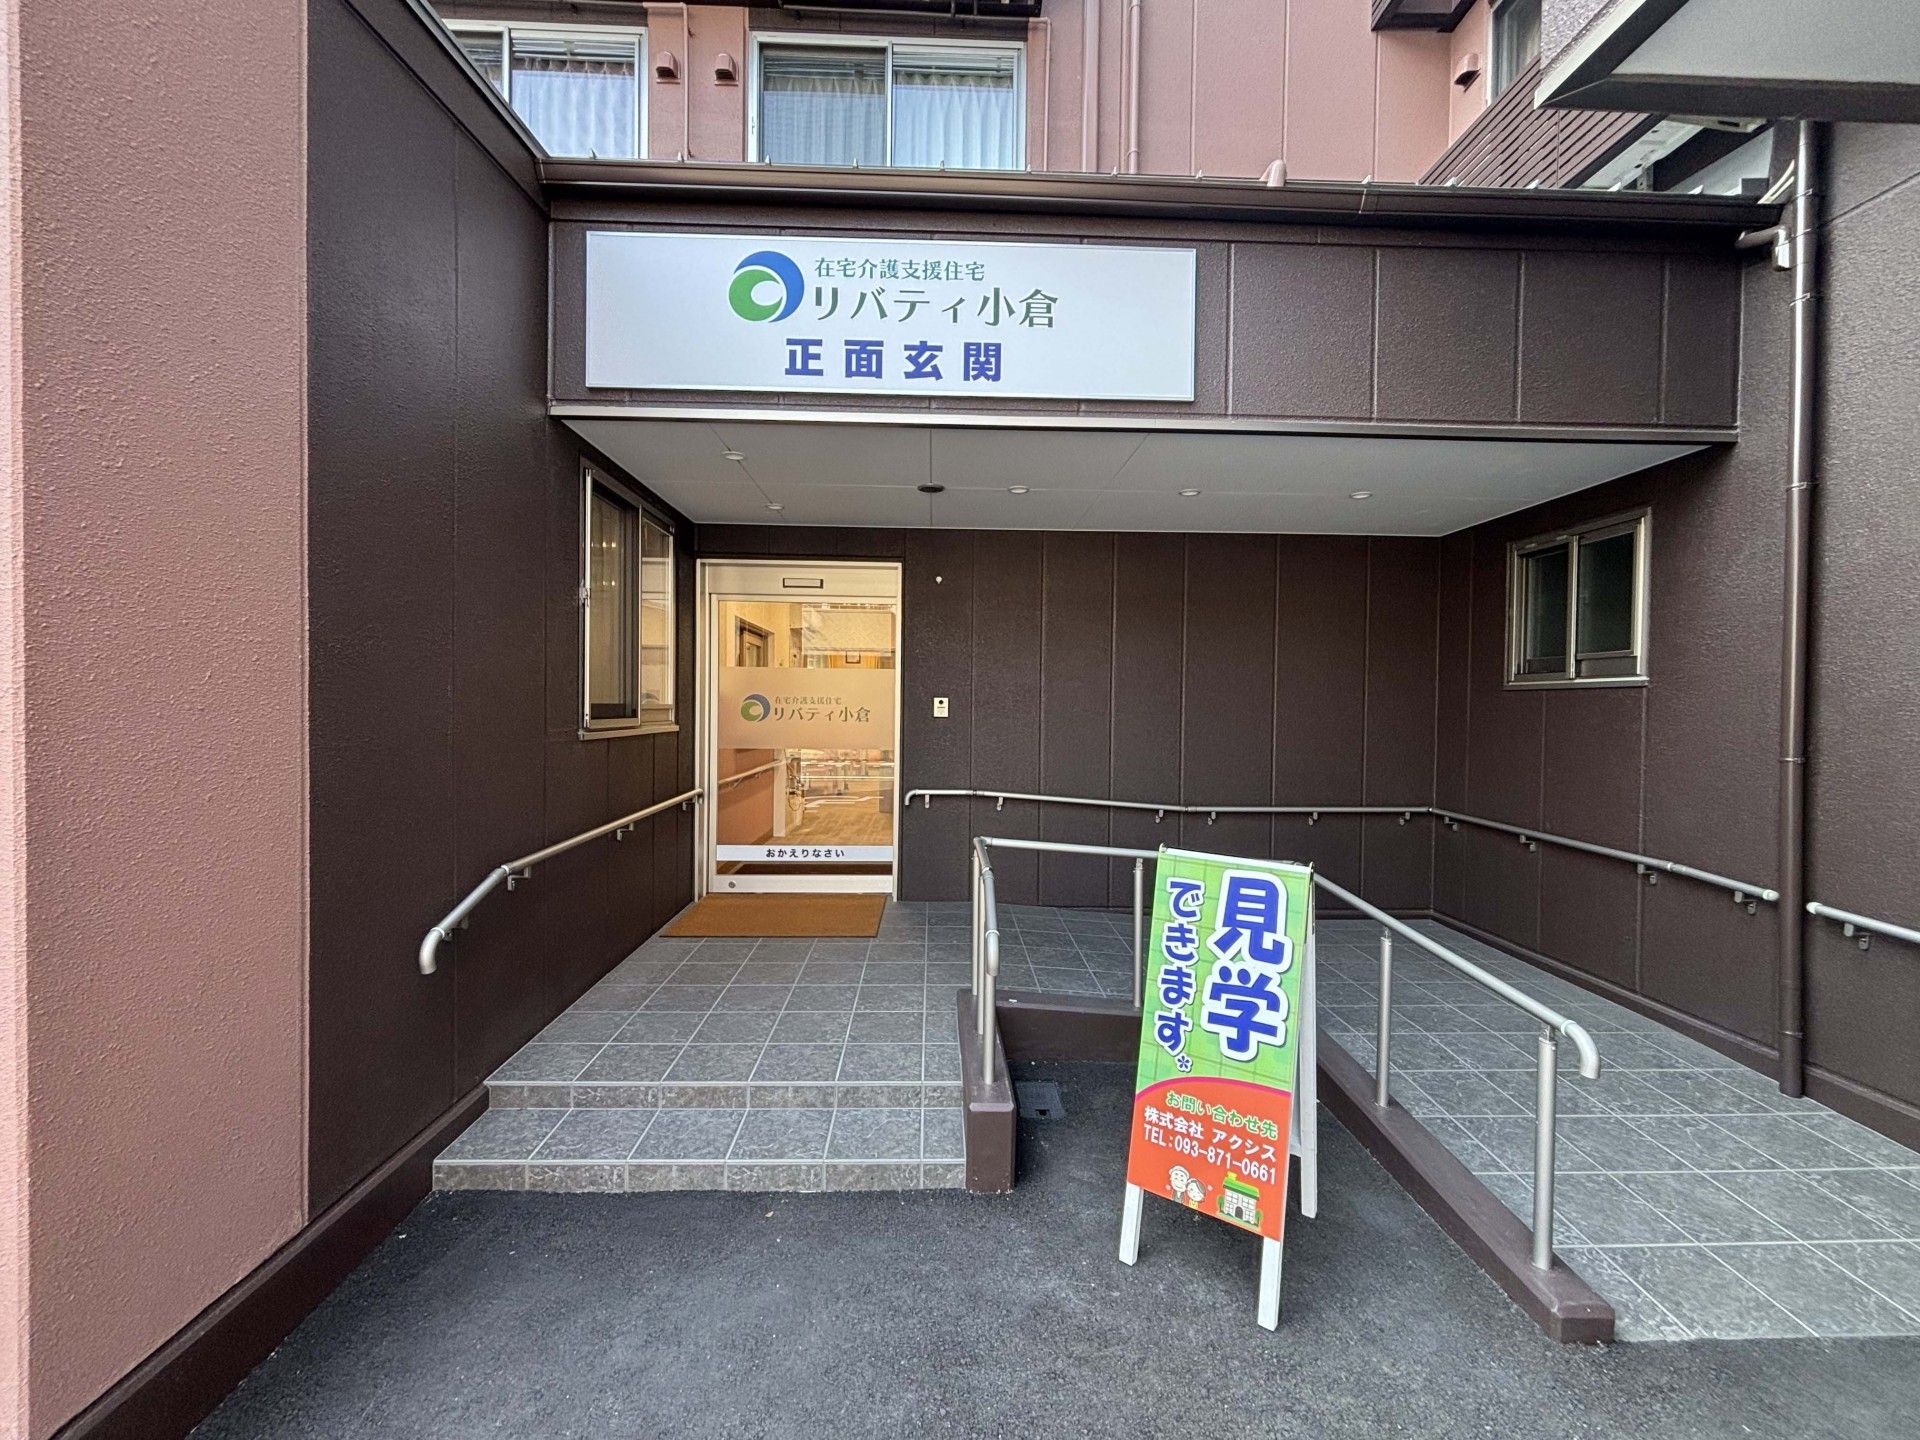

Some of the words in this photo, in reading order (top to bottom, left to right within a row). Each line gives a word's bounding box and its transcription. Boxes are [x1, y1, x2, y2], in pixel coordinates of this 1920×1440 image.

[815, 257, 985, 282] 在宅介護支援住宅
[814, 287, 1059, 328] リバティ小倉
[785, 338, 1003, 383] 正面玄関
[774, 706, 871, 723] リバティ小倉
[766, 848, 845, 858] おかえりなさい
[1207, 876, 1286, 1053] 見学
[1144, 1106, 1205, 1140] 株式会社
[1212, 1128, 1277, 1163] アクシス
[1166, 1090, 1278, 1139] お問い合わせ先
